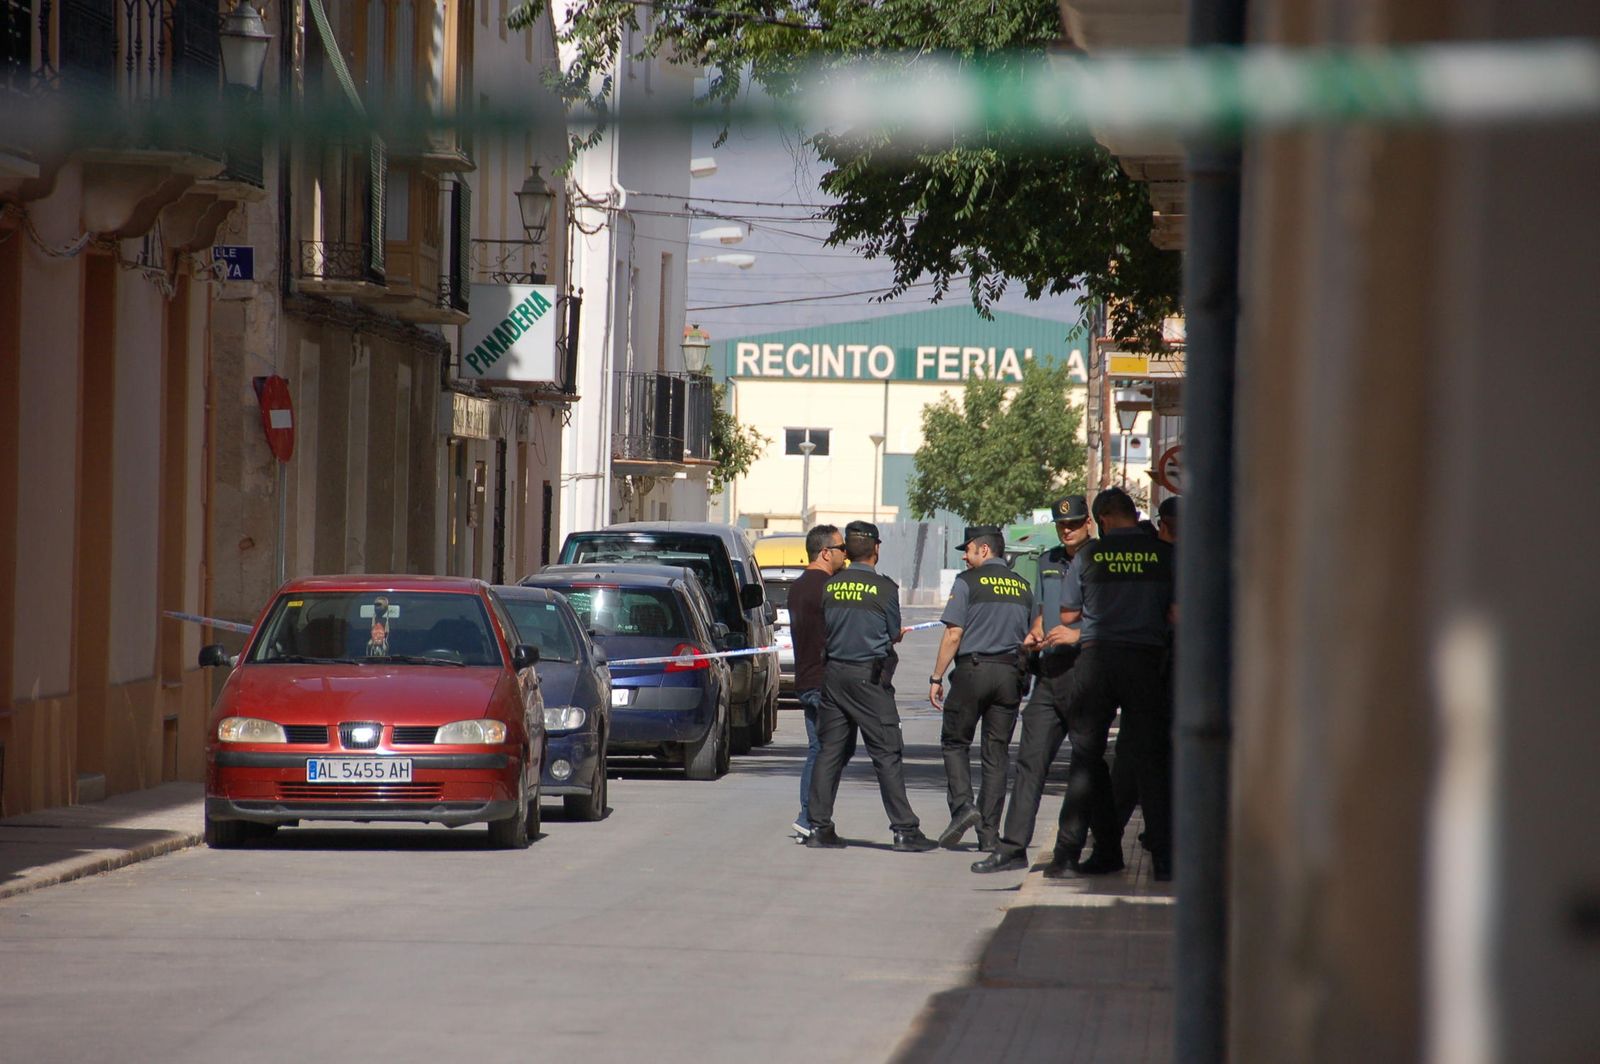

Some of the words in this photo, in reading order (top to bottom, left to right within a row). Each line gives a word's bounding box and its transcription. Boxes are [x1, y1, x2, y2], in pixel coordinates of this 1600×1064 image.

[464, 290, 552, 375] PANADERIA
[736, 342, 895, 378] RECINTO
[1094, 552, 1158, 562] GUARDIA
[1108, 563, 1144, 573] CIVIL
[826, 582, 878, 595] GUARDIA
[980, 577, 1027, 592] GUARDIA
[993, 586, 1020, 596] CIVIL
[834, 591, 862, 601] CIVIL
[318, 762, 337, 778] AL
[342, 762, 384, 778] 5455
[389, 762, 409, 778] AH
